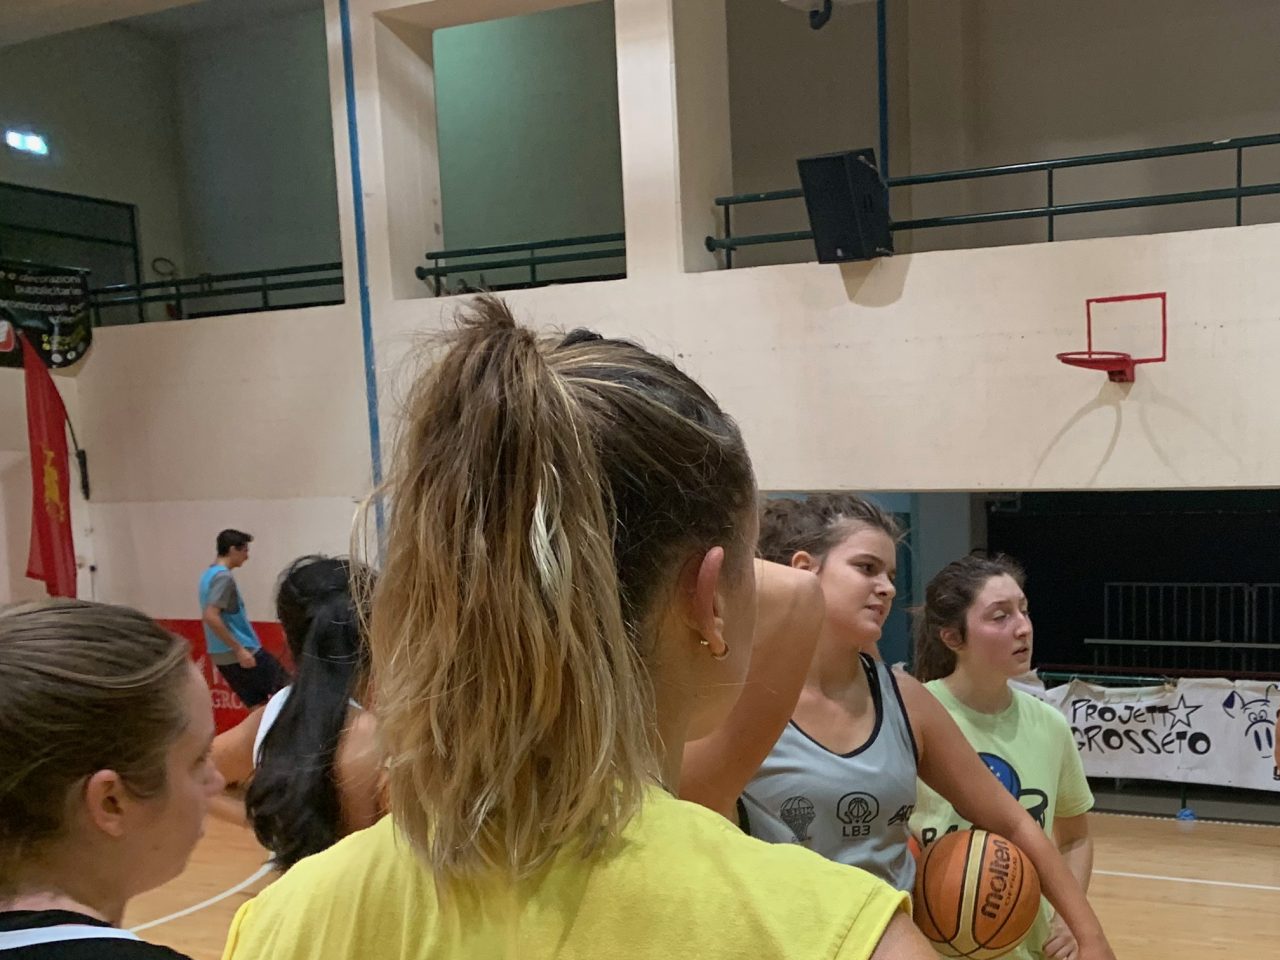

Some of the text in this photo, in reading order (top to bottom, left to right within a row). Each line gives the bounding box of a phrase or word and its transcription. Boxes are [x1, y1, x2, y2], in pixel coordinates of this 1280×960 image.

[1071, 724, 1211, 756] GROSSETO
[842, 825, 871, 838] LB3
[981, 839, 1011, 919] molten
